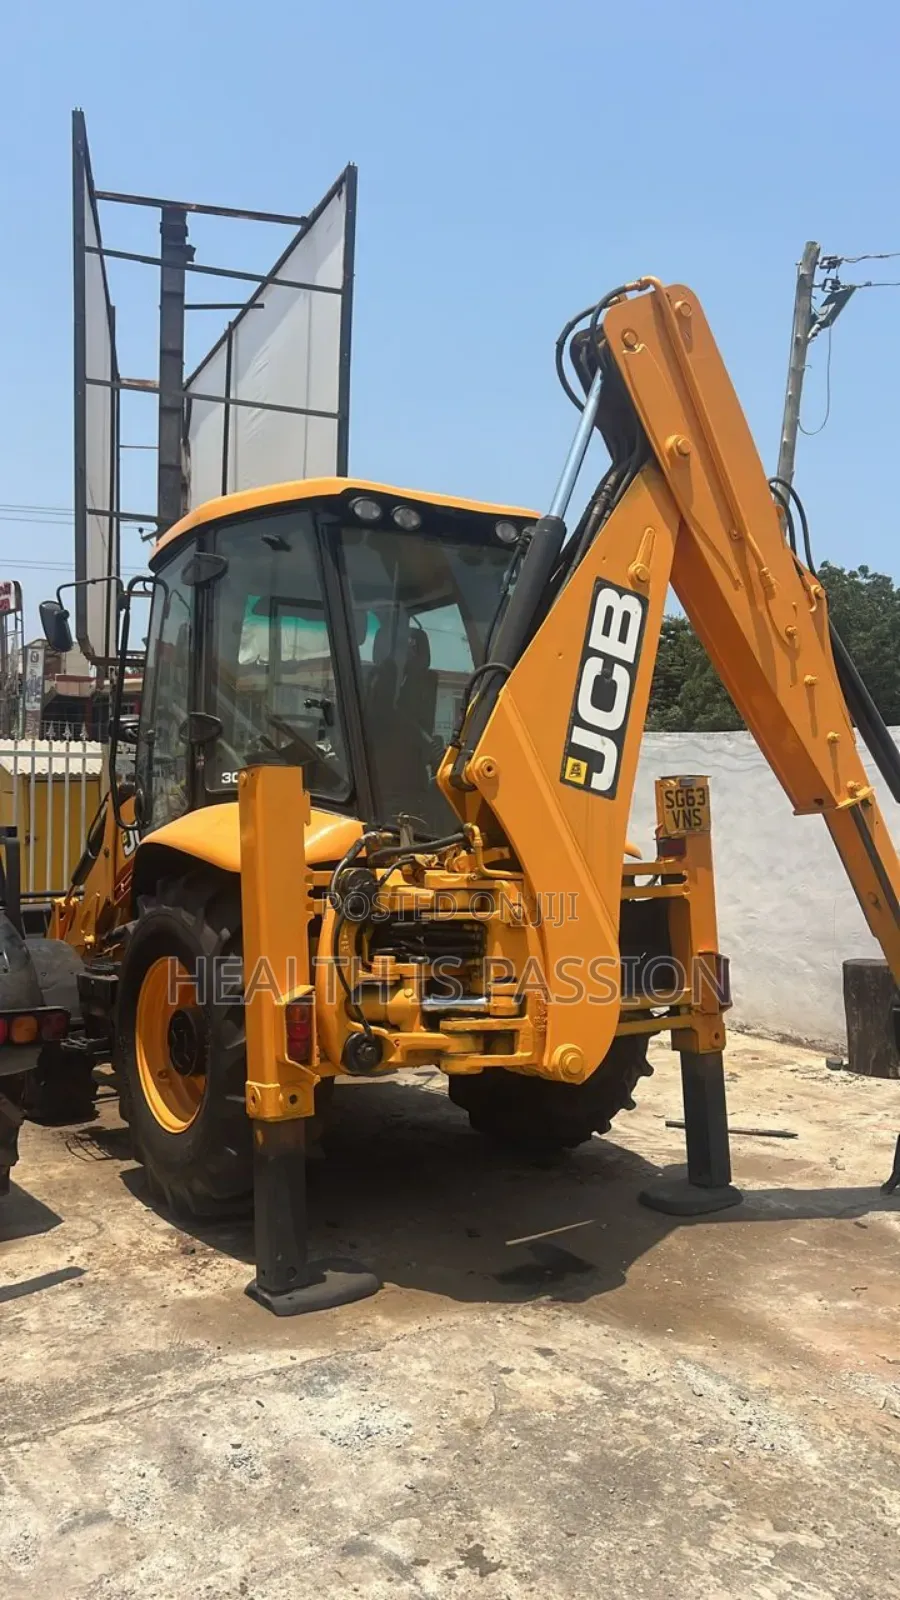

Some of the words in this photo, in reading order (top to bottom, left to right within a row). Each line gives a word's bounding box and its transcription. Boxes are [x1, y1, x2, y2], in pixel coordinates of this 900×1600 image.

[571, 588, 643, 791] JCB
[221, 772, 239, 783] 3C
[664, 787, 706, 810] SG63
[672, 808, 702, 829] VNS
